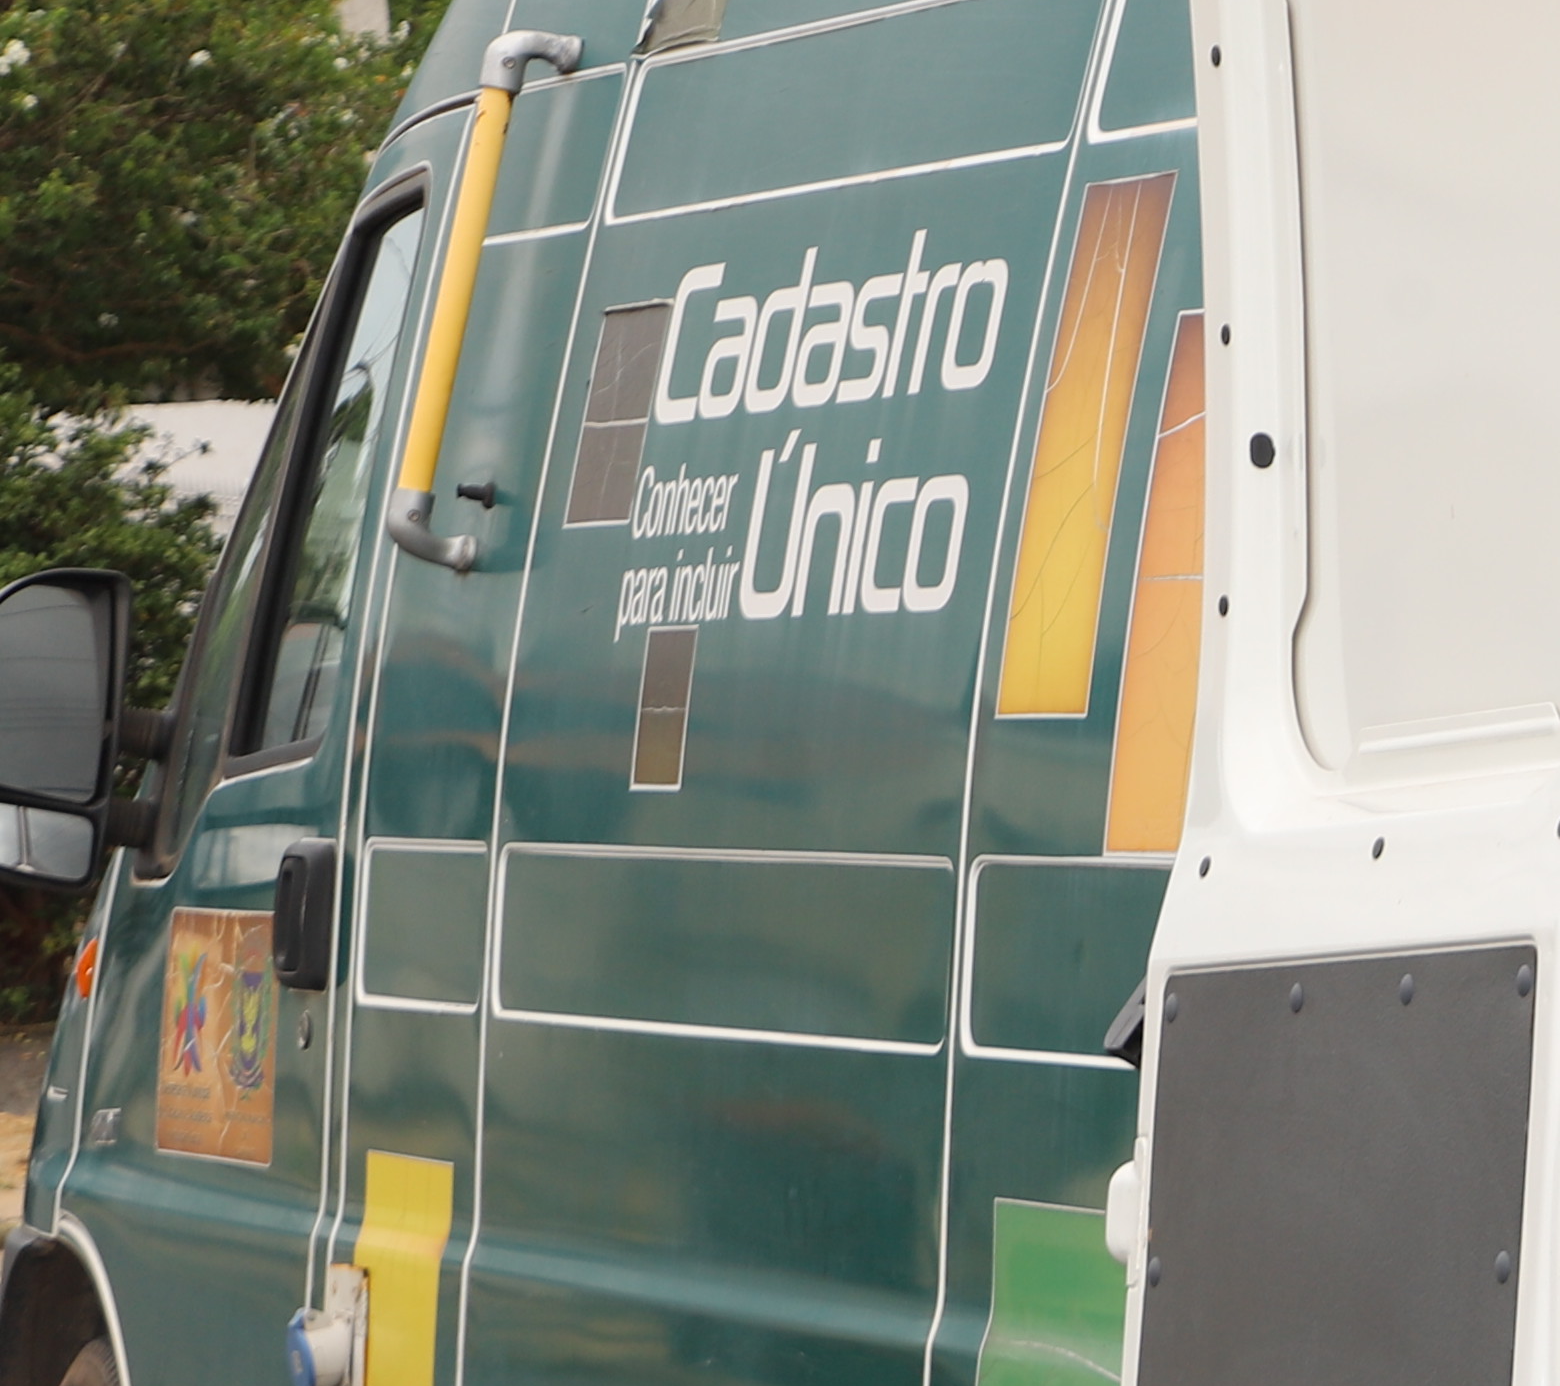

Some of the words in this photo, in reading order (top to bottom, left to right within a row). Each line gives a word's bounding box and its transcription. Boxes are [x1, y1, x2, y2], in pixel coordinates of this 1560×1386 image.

[655, 229, 1009, 425] Cadastro
[632, 463, 738, 540] Conhecer
[739, 429, 969, 619] Único
[613, 560, 666, 643] para
[667, 546, 741, 623] incluir
